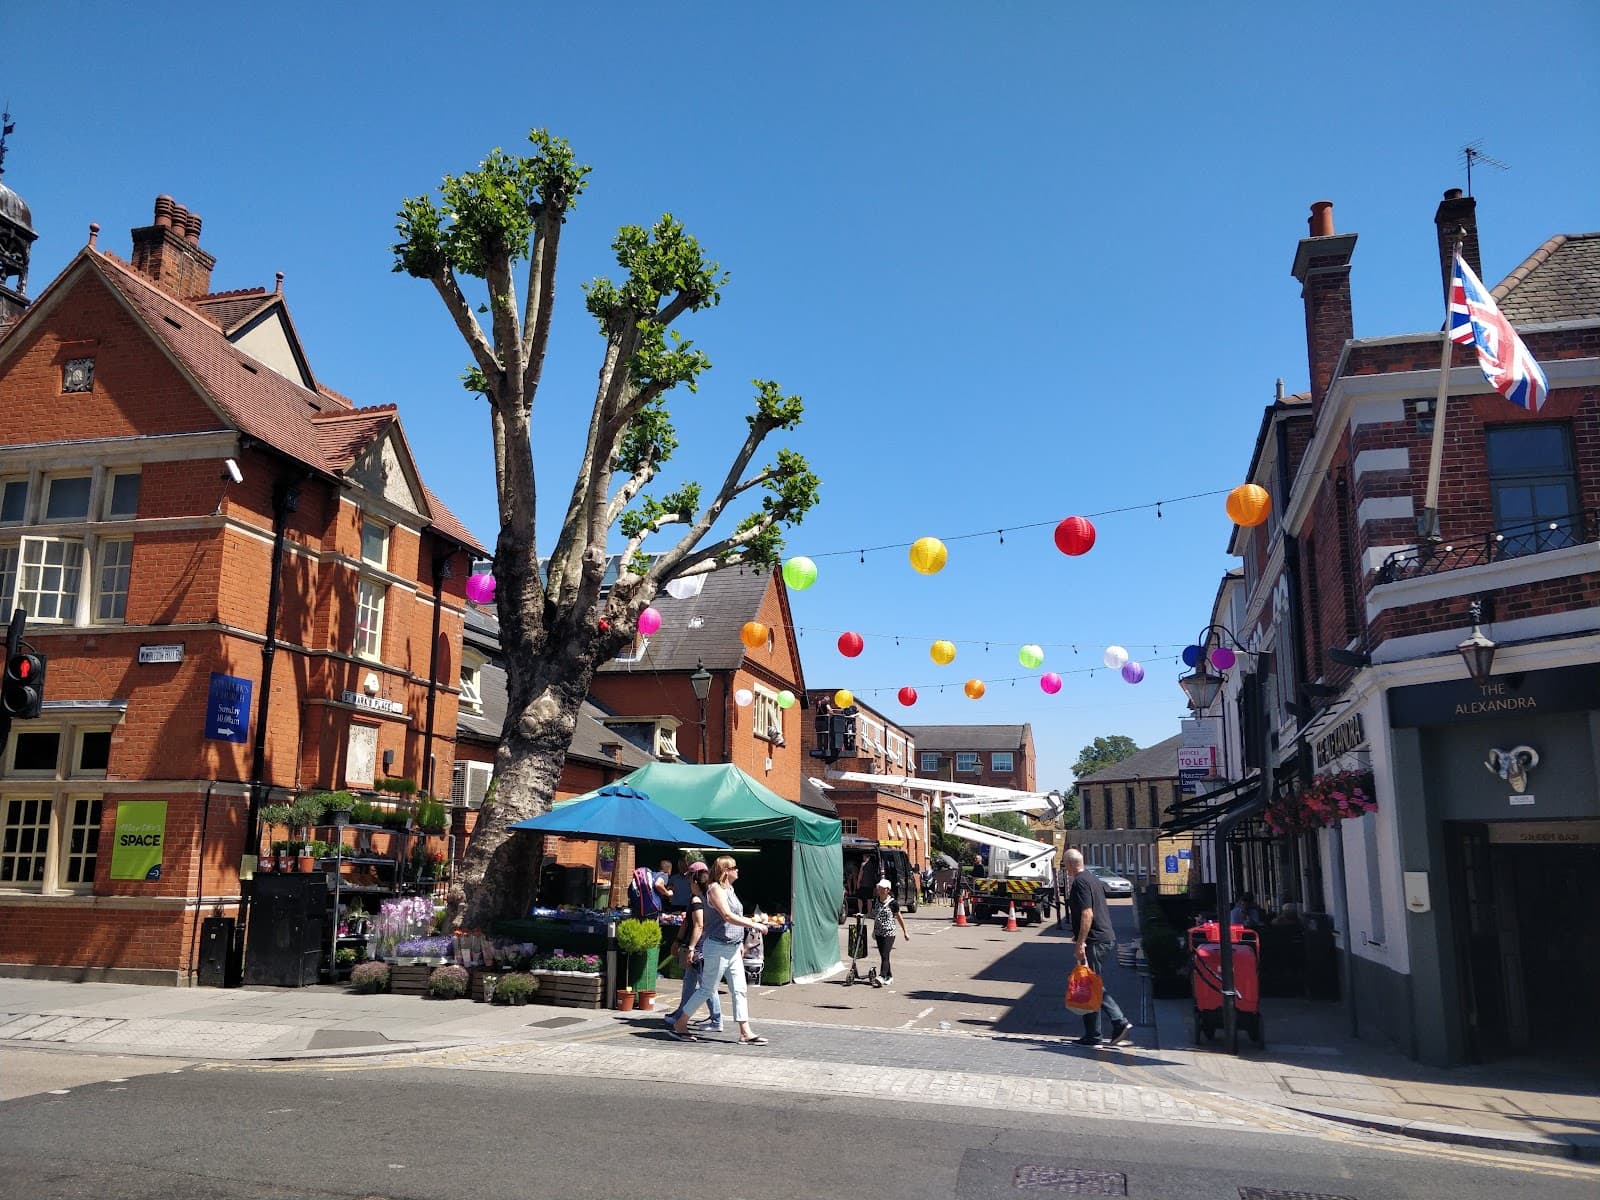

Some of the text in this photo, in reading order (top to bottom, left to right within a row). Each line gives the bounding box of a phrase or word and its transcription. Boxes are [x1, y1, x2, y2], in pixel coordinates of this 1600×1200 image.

[1480, 683, 1504, 696] THE
[218, 704, 240, 717] Sunday
[1456, 697, 1536, 714] ALEXANDRA
[1180, 758, 1209, 766] TO LET
[120, 834, 161, 847] SPACE
